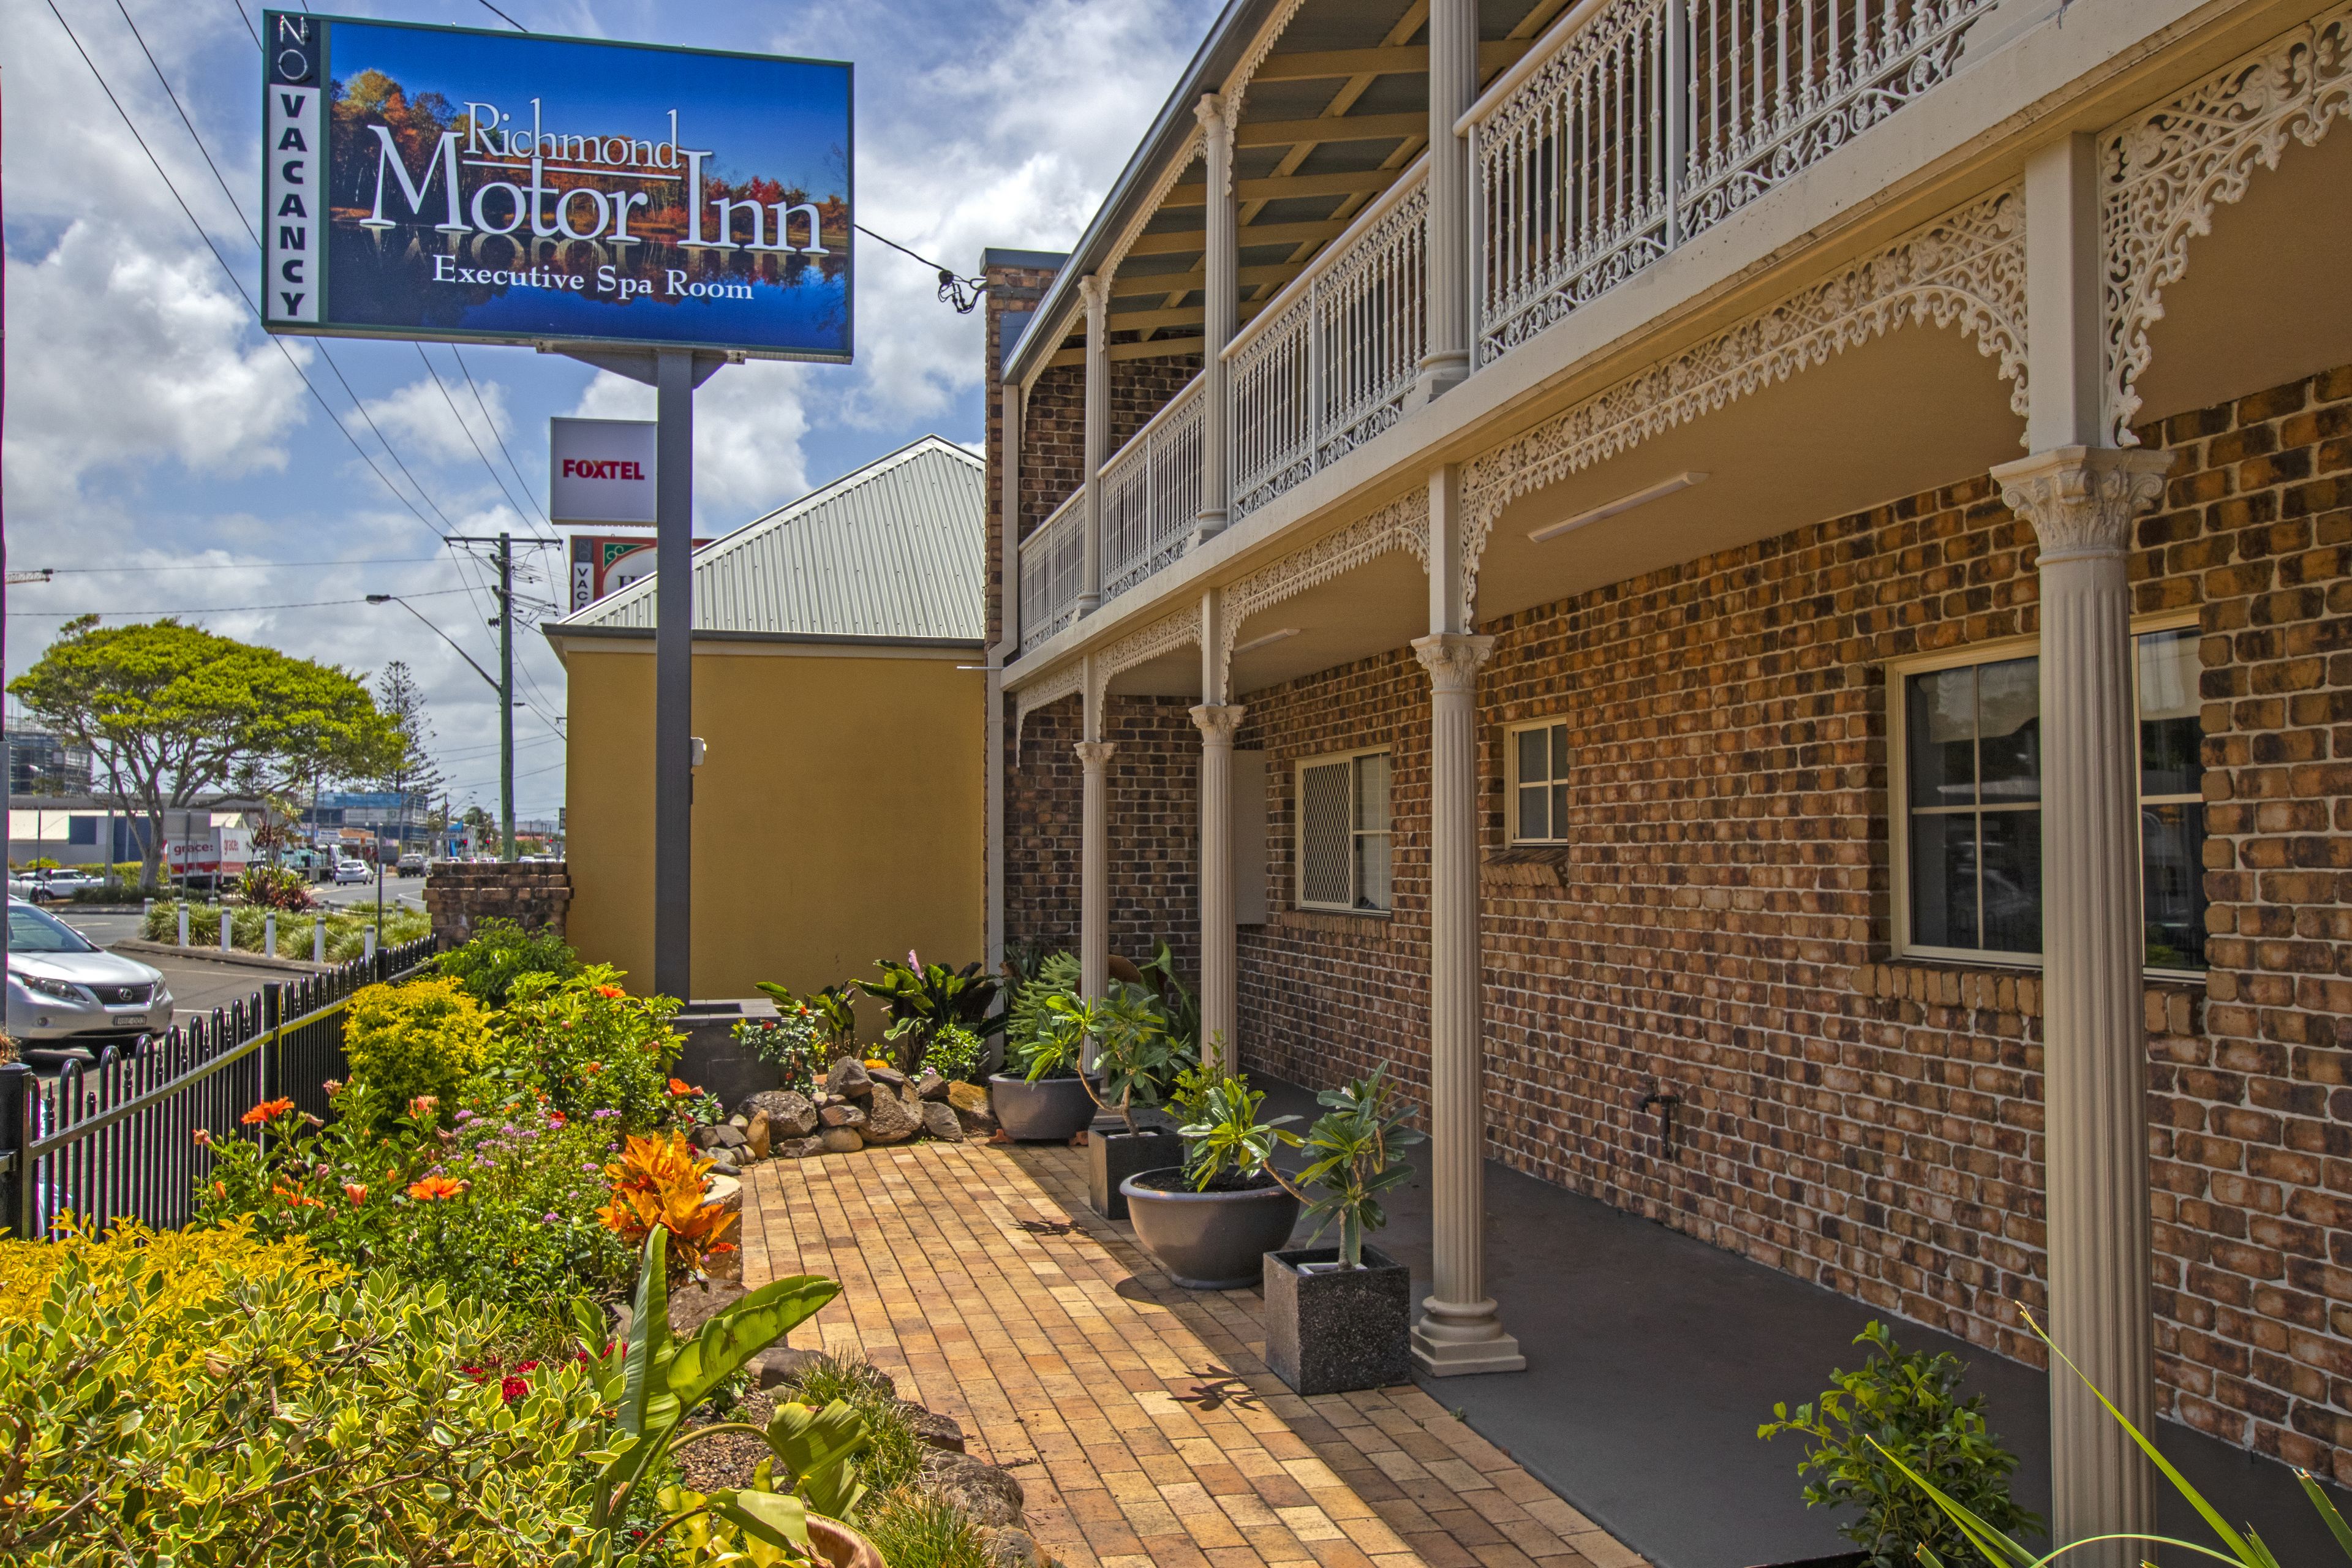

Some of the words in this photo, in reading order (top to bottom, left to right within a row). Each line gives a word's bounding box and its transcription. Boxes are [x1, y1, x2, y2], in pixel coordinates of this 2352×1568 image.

[278, 14, 309, 80] NO
[463, 97, 682, 170] Richmond
[277, 93, 307, 317] VACANCY
[359, 124, 649, 240] Motor
[676, 148, 829, 254] Inn
[432, 254, 584, 290] Executive
[597, 264, 654, 300] Spa
[665, 269, 755, 300] Room
[562, 459, 645, 481] FOXTEL
